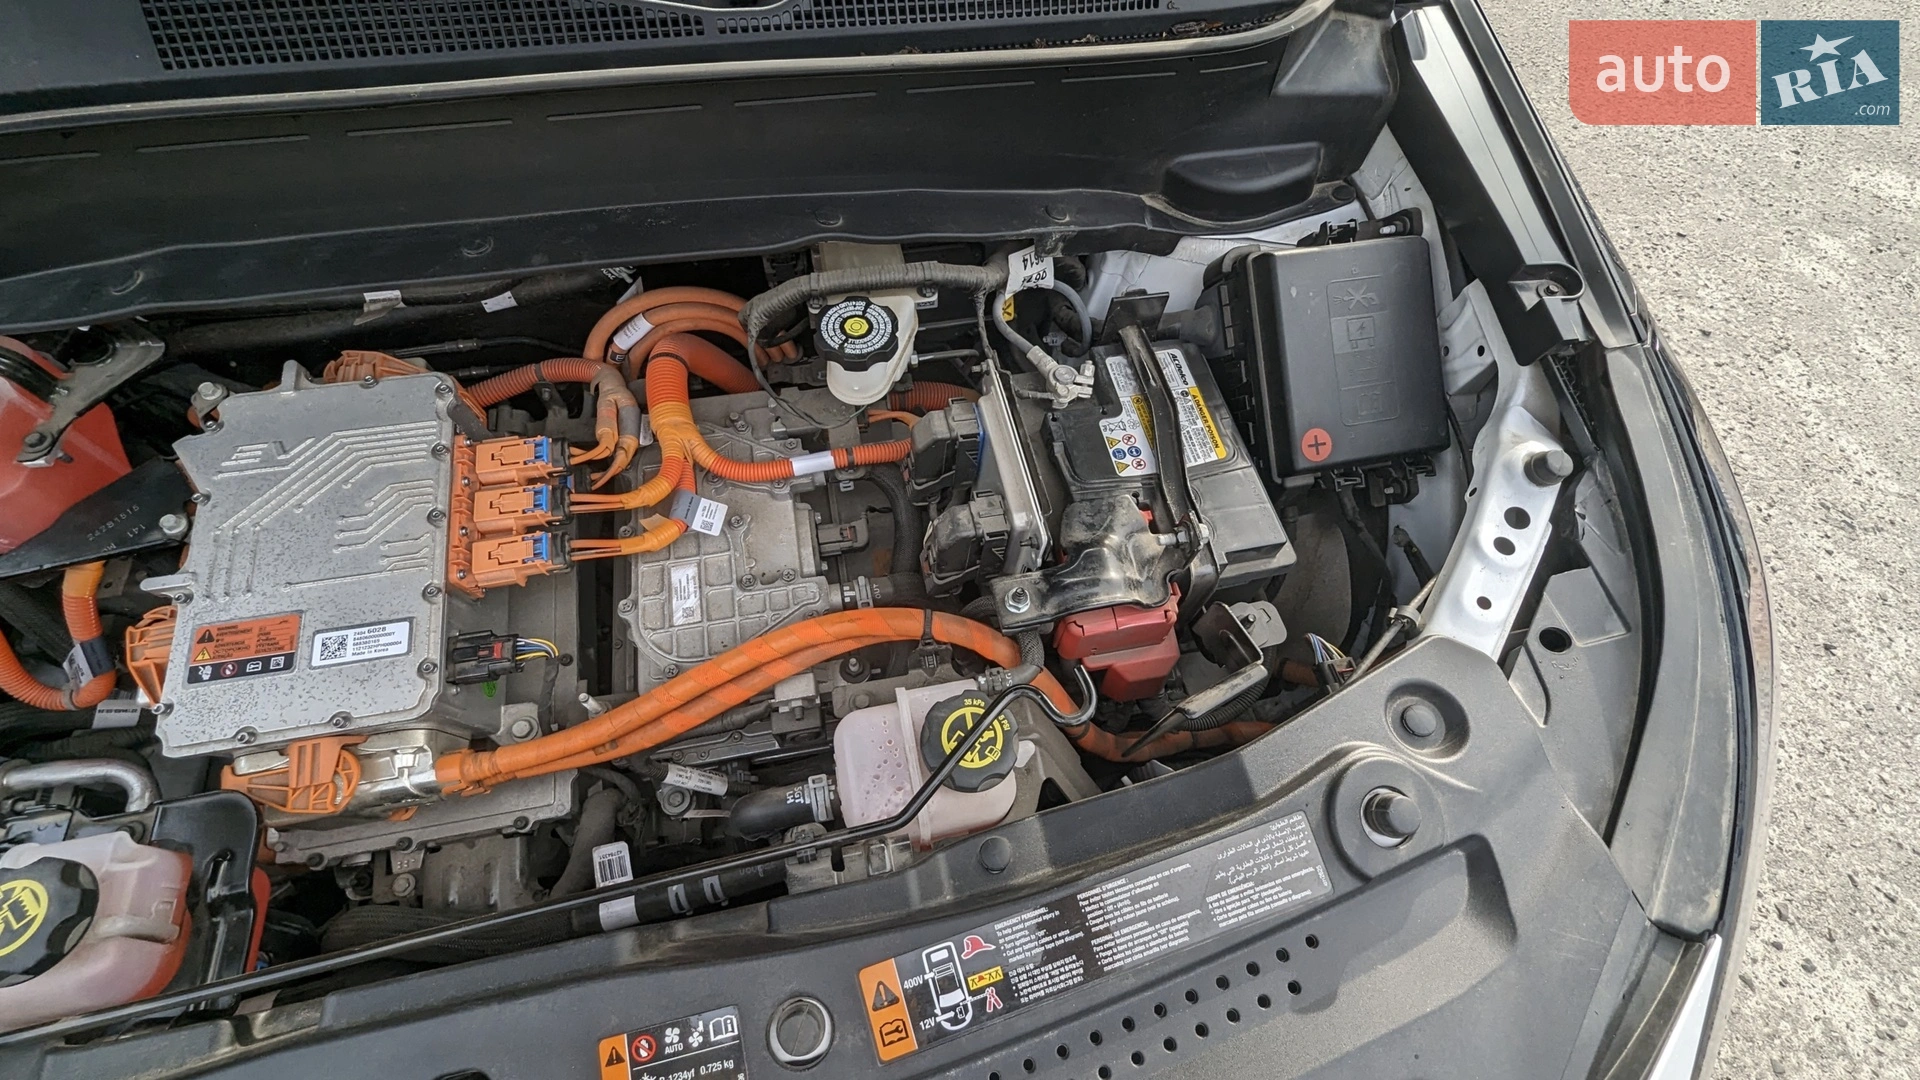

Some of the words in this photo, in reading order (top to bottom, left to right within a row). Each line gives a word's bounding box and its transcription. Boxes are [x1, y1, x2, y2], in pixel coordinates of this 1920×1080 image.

[1169, 352, 1188, 386] ACDelco
[963, 698, 972, 706] 35
[972, 698, 985, 707] kPa
[793, 786, 803, 803] SGT
[904, 974, 924, 989] 400V
[920, 1016, 935, 1030] 12V
[664, 1043, 683, 1054] AUTO
[701, 1062, 722, 1075] 0.725
[723, 1059, 734, 1071] kg
